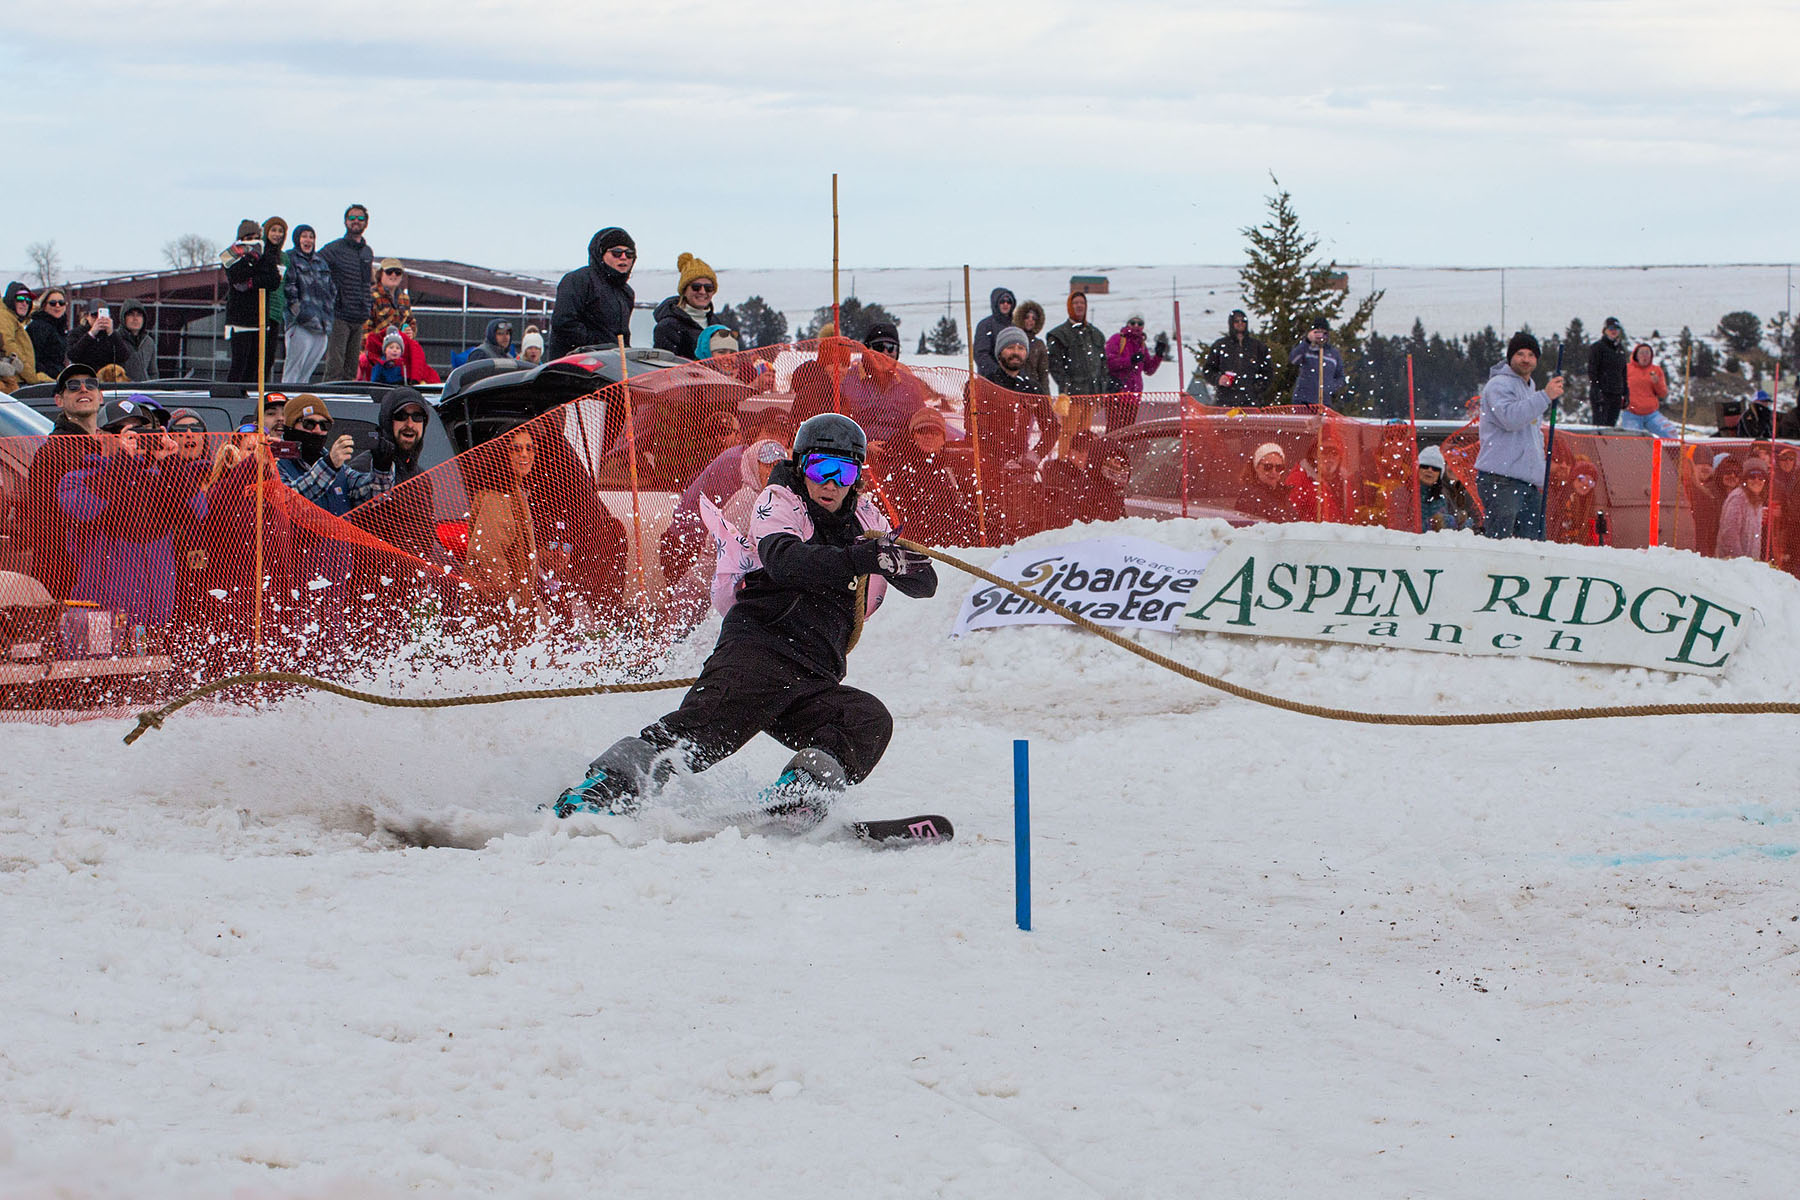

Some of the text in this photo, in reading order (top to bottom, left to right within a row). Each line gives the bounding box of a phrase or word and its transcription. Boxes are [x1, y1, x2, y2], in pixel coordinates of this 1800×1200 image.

[1018, 557, 1199, 597] Sibanye
[1148, 562, 1175, 573] are
[1185, 556, 1742, 668] ASPEN RIDGE
[1319, 620, 1584, 653] ranch
